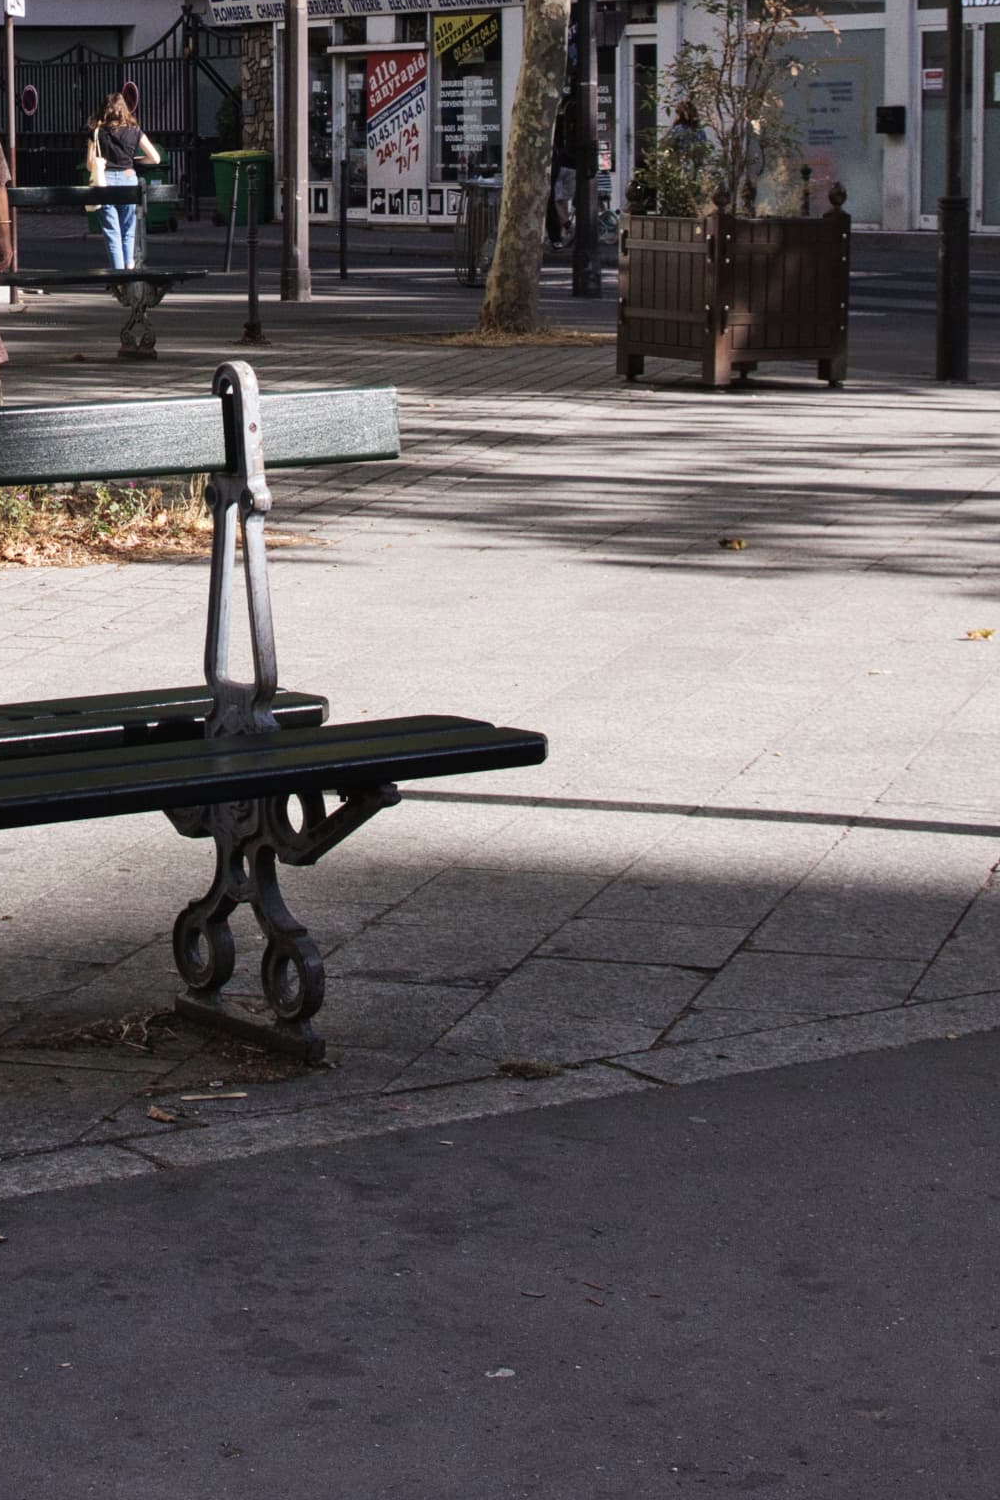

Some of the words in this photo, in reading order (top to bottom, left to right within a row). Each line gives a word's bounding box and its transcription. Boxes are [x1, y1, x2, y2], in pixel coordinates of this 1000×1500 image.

[213, 4, 253, 22] PLOMBERIE
[257, 0, 285, 19] CHAUFF
[436, 20, 454, 42] allo
[437, 16, 474, 52] sanyrapid
[369, 59, 398, 92] allo
[369, 52, 427, 108] sanyrapid
[368, 97, 426, 151] 01.45.77.04.61
[376, 122, 420, 167] 24h/24
